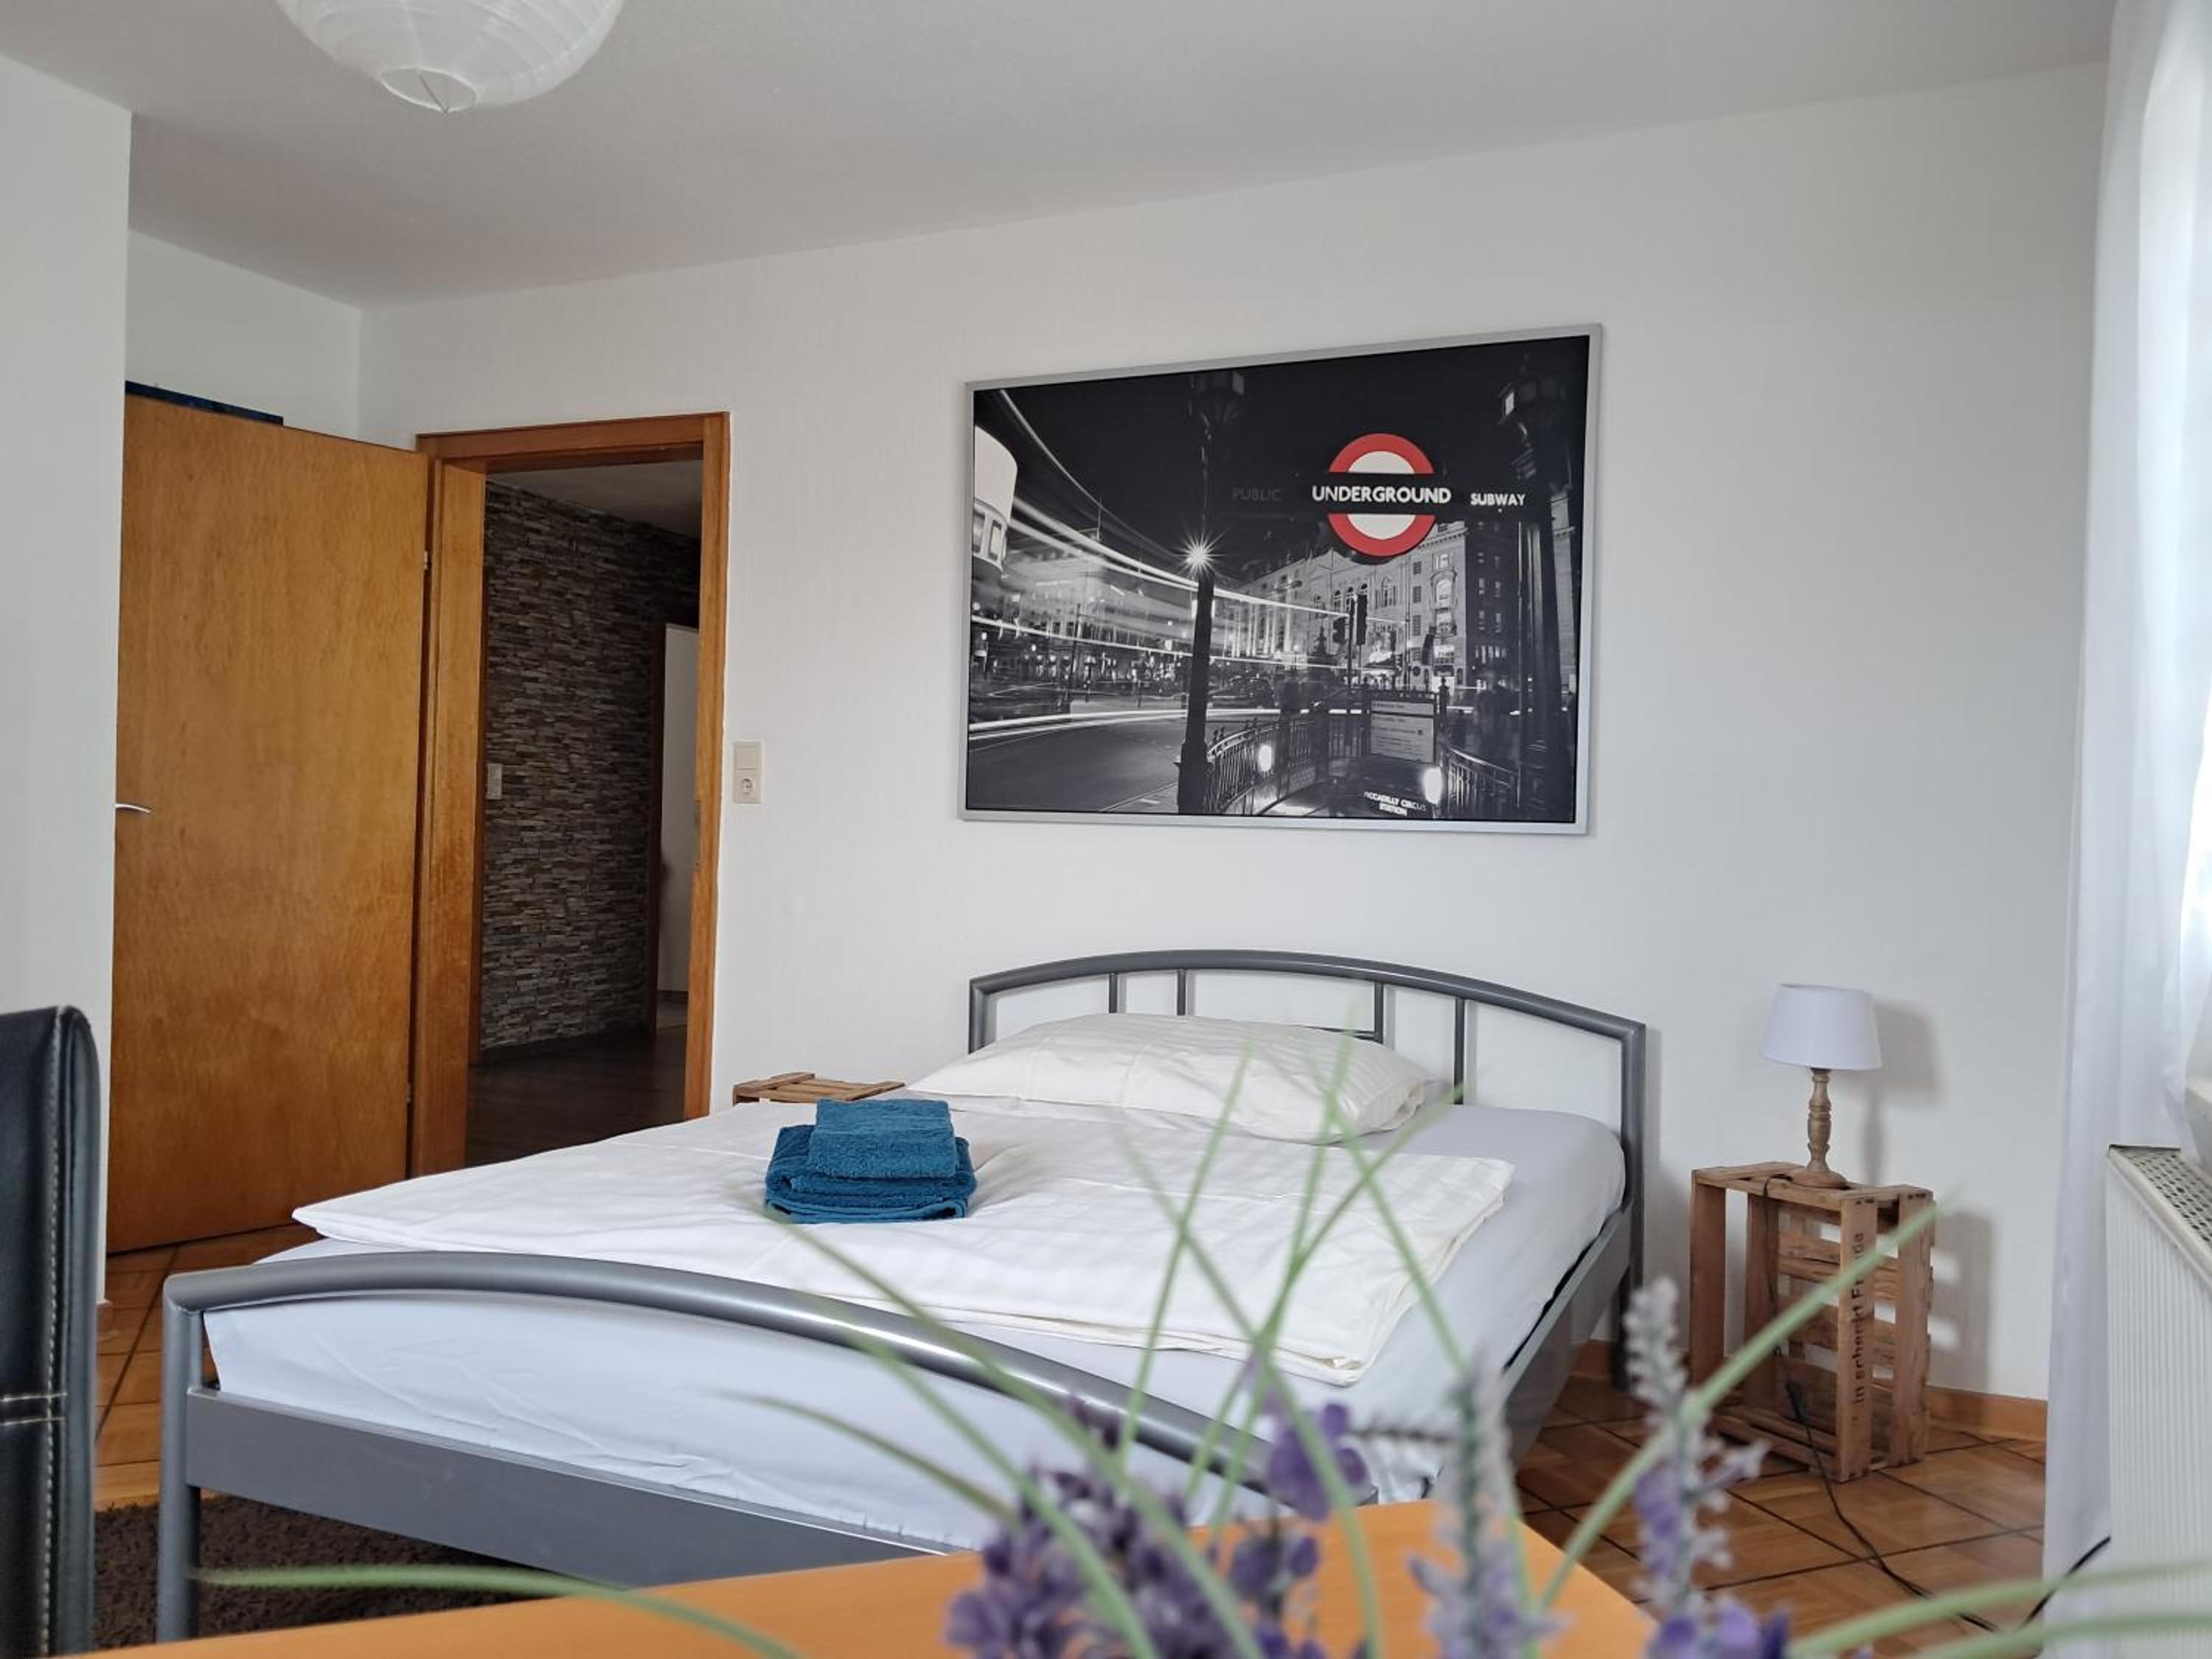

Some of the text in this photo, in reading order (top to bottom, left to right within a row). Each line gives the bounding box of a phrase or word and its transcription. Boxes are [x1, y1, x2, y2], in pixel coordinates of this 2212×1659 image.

[1232, 486, 1282, 501] PUBLIC
[1312, 485, 1452, 504] UNDERGROUND
[1470, 493, 1526, 507] SUBWAY
[1379, 802, 1408, 817] STATION
